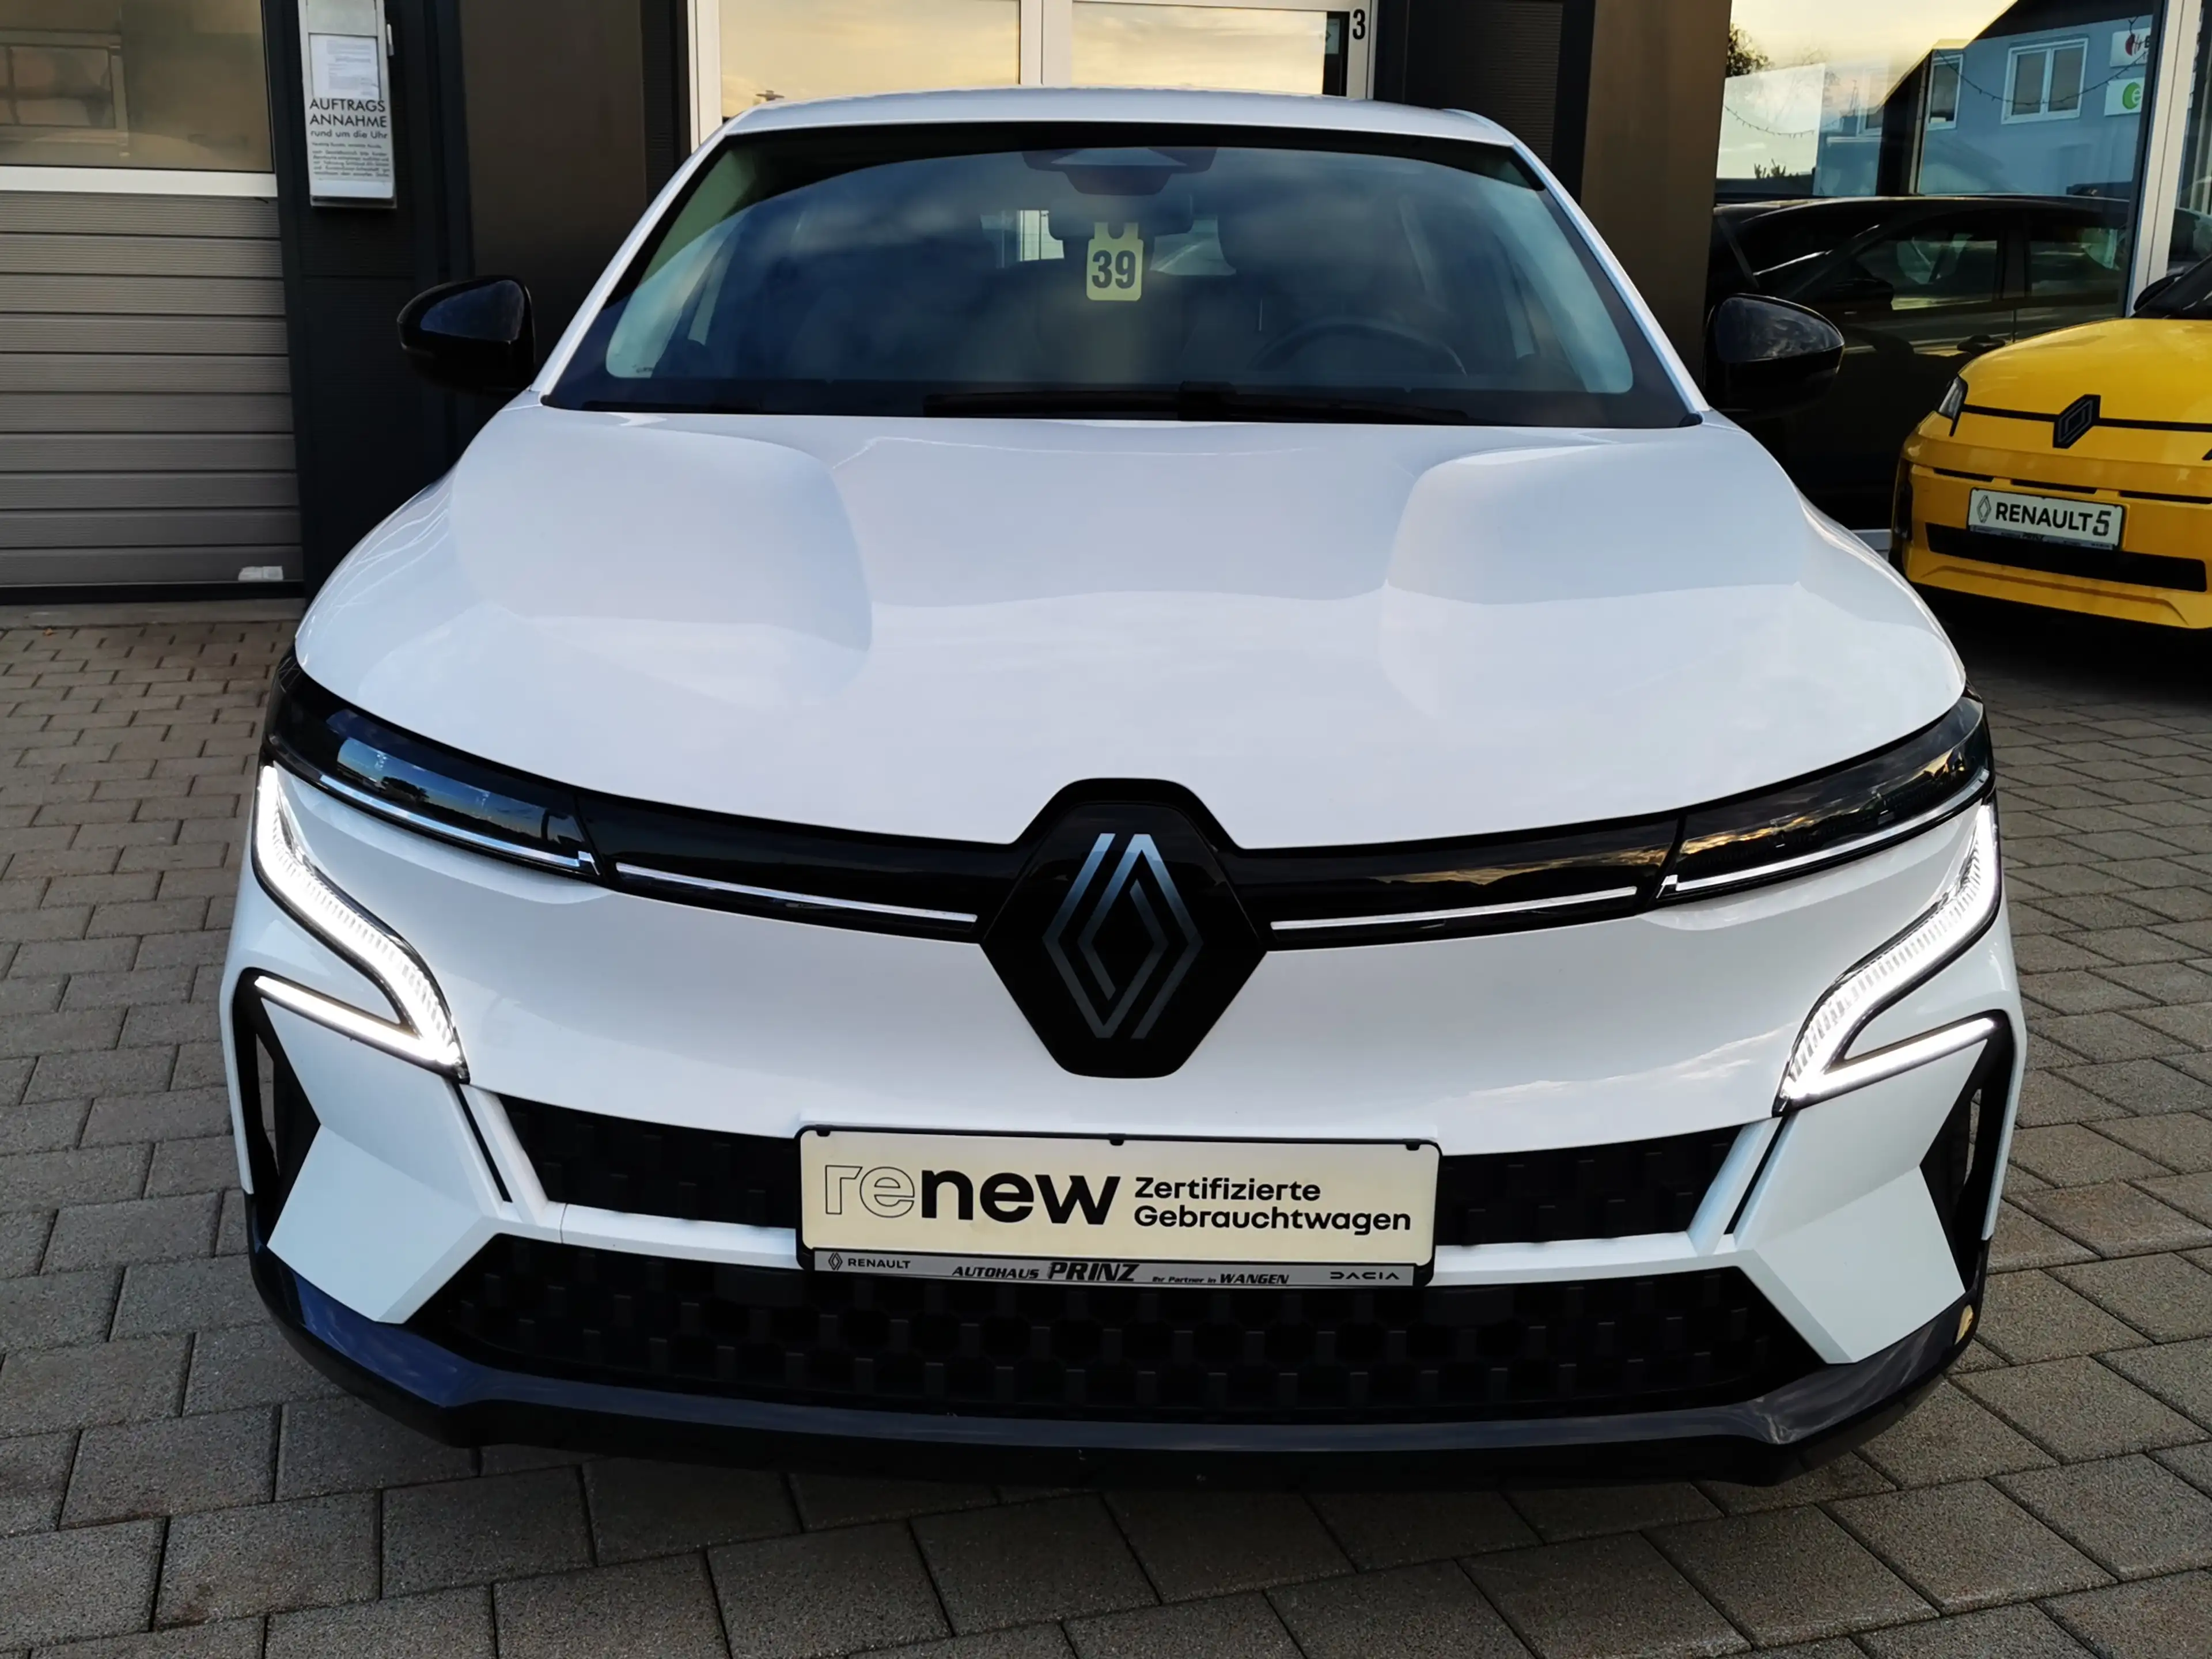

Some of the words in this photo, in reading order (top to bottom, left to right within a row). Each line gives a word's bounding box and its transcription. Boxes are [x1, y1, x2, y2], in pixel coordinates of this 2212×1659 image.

[1353, 9, 1365, 40] 3
[309, 99, 385, 112] AUFTRAGS
[309, 114, 387, 128] ANNAHME
[310, 129, 332, 137] rund
[353, 130, 368, 138] die
[370, 131, 388, 139] Uhr
[1092, 249, 1136, 289] 39
[825, 1165, 1121, 1225] renew
[1134, 1176, 1321, 1202] Zertifizierte
[1134, 1205, 1411, 1236] Gebrauchtwagen
[848, 1258, 911, 1269] RENAULT
[952, 1266, 1039, 1279] AUTOHAUS
[1047, 1261, 1140, 1282] PRINZ
[1219, 1273, 1289, 1285] WANGEN
[1330, 1271, 1400, 1280] DACIA
